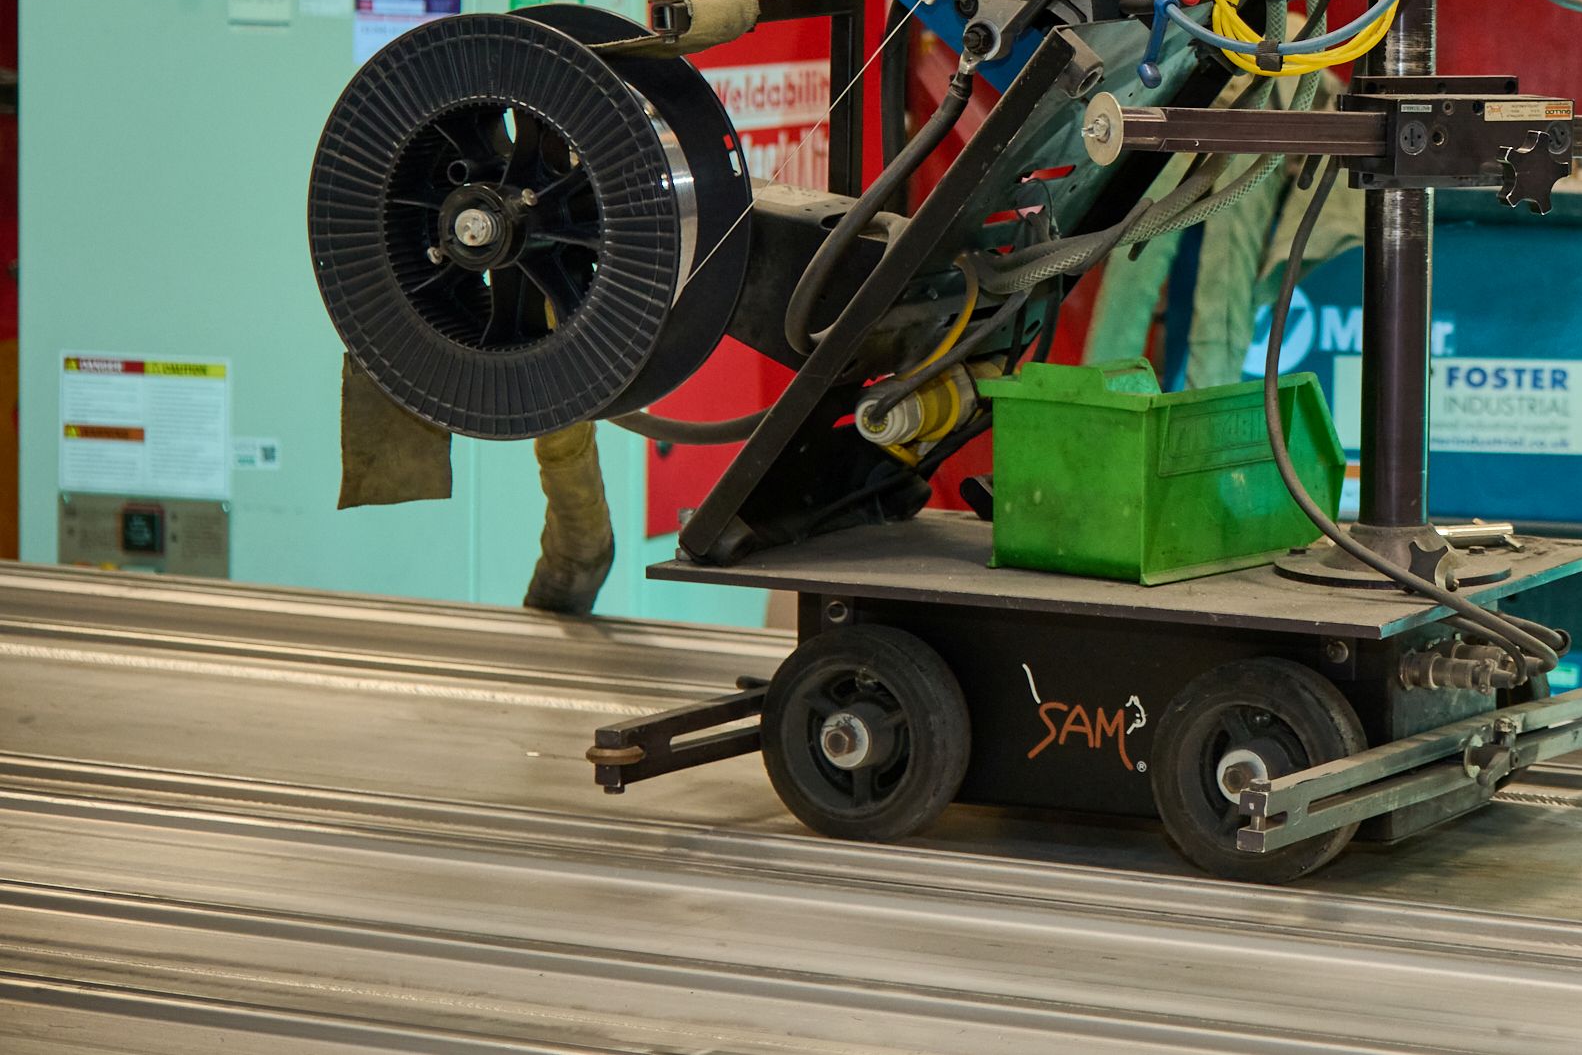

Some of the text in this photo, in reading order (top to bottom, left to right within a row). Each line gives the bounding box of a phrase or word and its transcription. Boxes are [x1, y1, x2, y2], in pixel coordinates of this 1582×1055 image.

[1446, 366, 1568, 390] FOSTER
[1443, 396, 1570, 417] INDUSTRIAL
[1028, 702, 1134, 771] SAM
